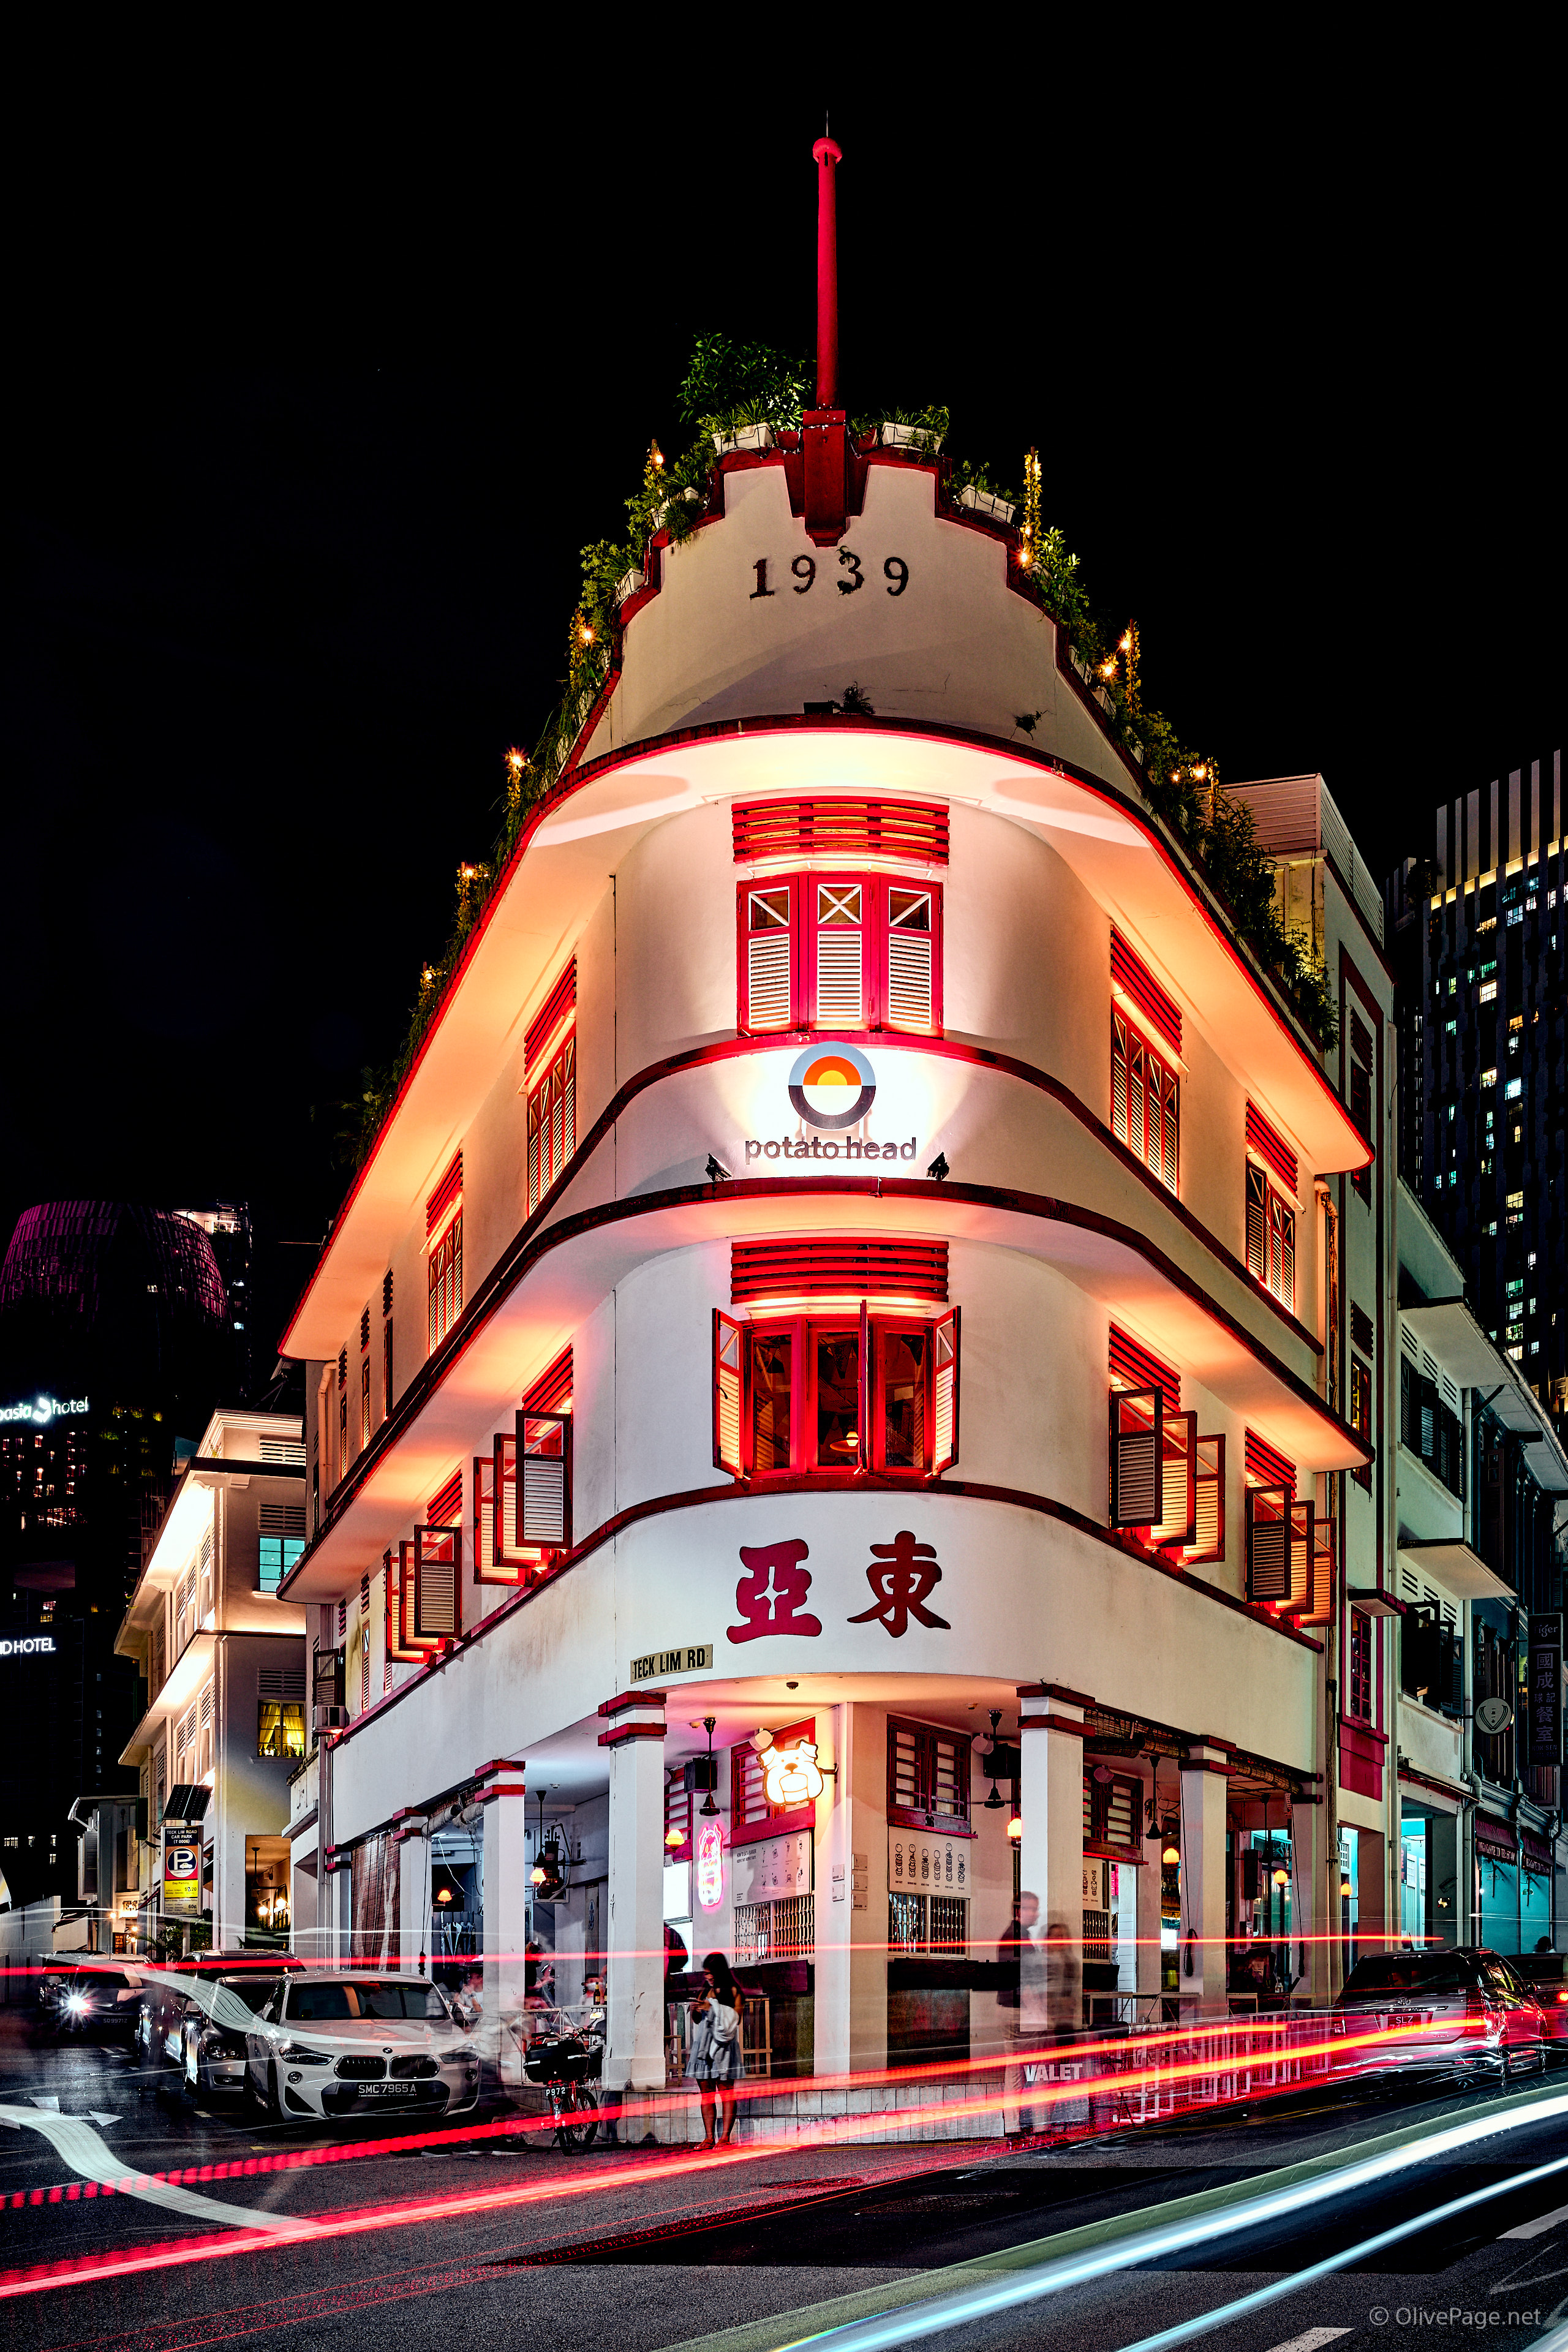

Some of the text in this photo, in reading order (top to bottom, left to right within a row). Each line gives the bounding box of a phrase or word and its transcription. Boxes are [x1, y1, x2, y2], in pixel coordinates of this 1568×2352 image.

[749, 552, 910, 599] 1939
[745, 1136, 916, 1165] potato head
[52, 1396, 88, 1415] hotel
[13, 1637, 56, 1654] HOTEL
[633, 1648, 705, 1680] TECK LIM RD
[1395, 2015, 1414, 2024] SLZ
[1023, 2063, 1083, 2082] VALET
[546, 2087, 566, 2097] P972
